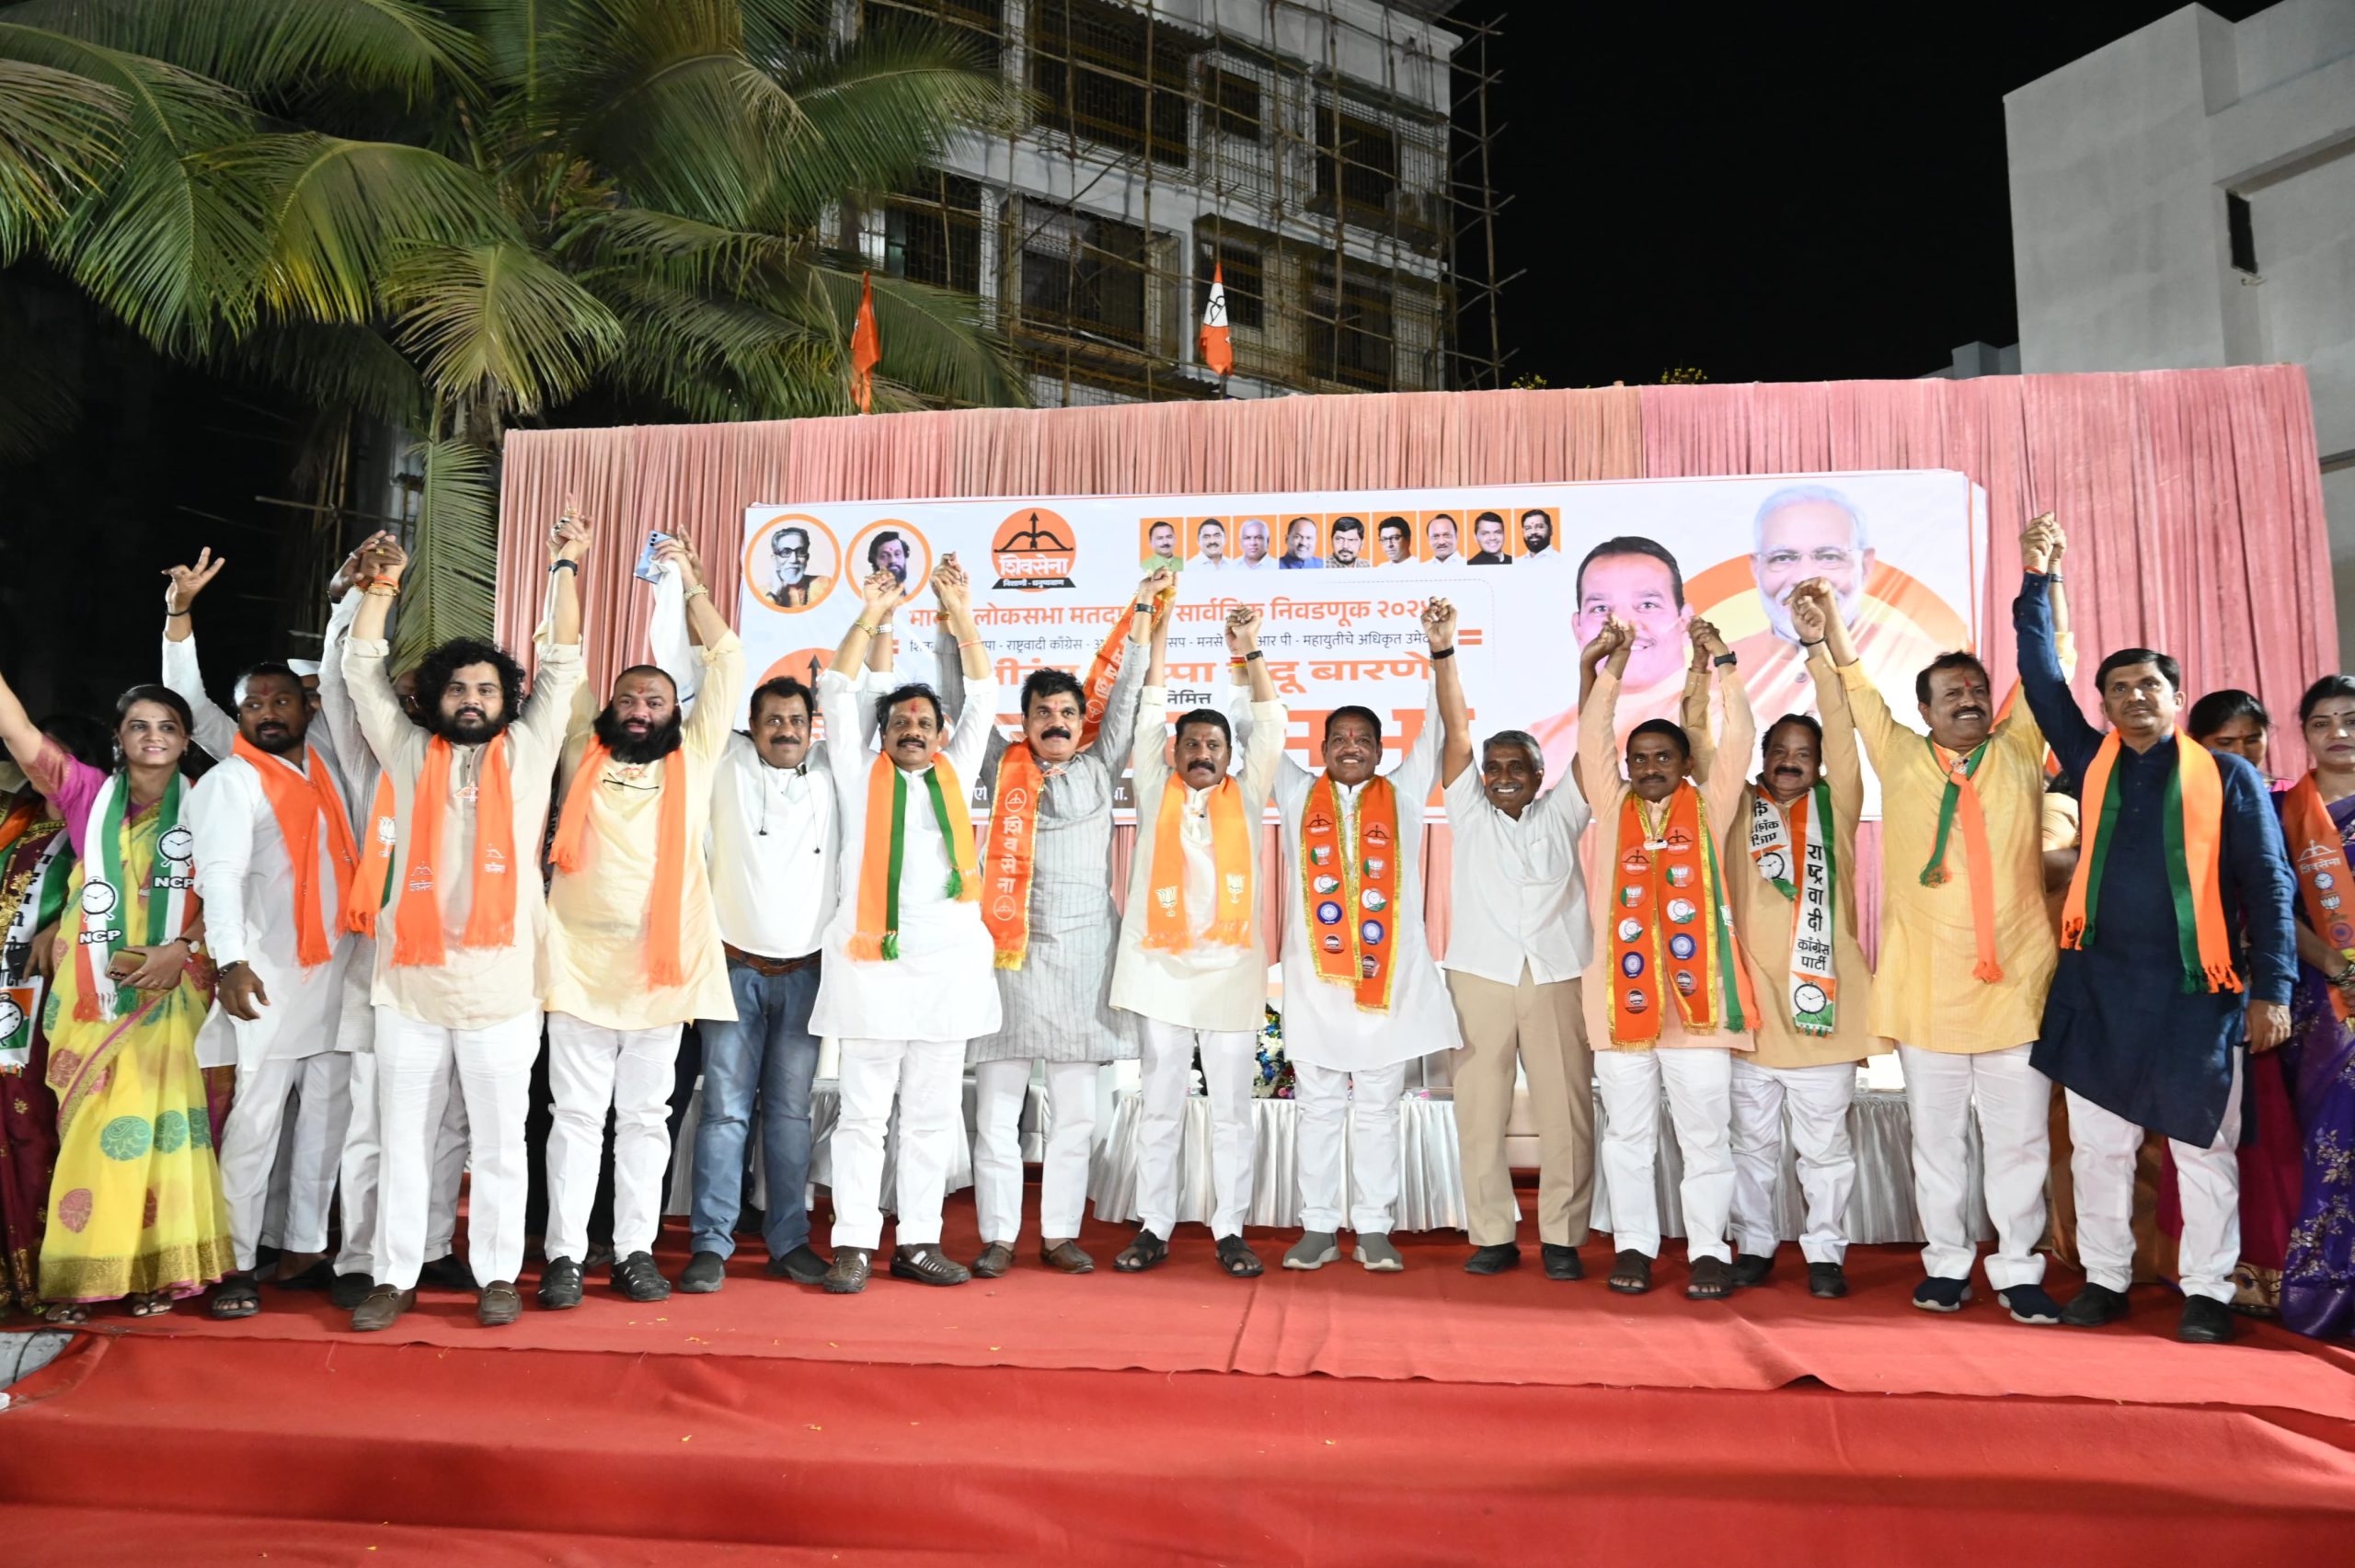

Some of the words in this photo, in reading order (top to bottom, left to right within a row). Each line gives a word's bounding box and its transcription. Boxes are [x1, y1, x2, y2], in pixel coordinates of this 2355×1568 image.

[998, 553, 1069, 577] शिवसेना
[972, 601, 1064, 626] लोकसभा
[1269, 596, 1372, 627] निवडणूक
[1006, 636, 1047, 653] राष्ट्रवादी
[1197, 633, 1223, 647] मनसे
[1303, 633, 1354, 649] महायुतीचे
[1358, 631, 1402, 648] अधिकृत
[1308, 651, 1430, 681] बारणे
[154, 876, 194, 889] NCP
[79, 929, 121, 944] NCP
[1800, 955, 1826, 971] पार्टी
